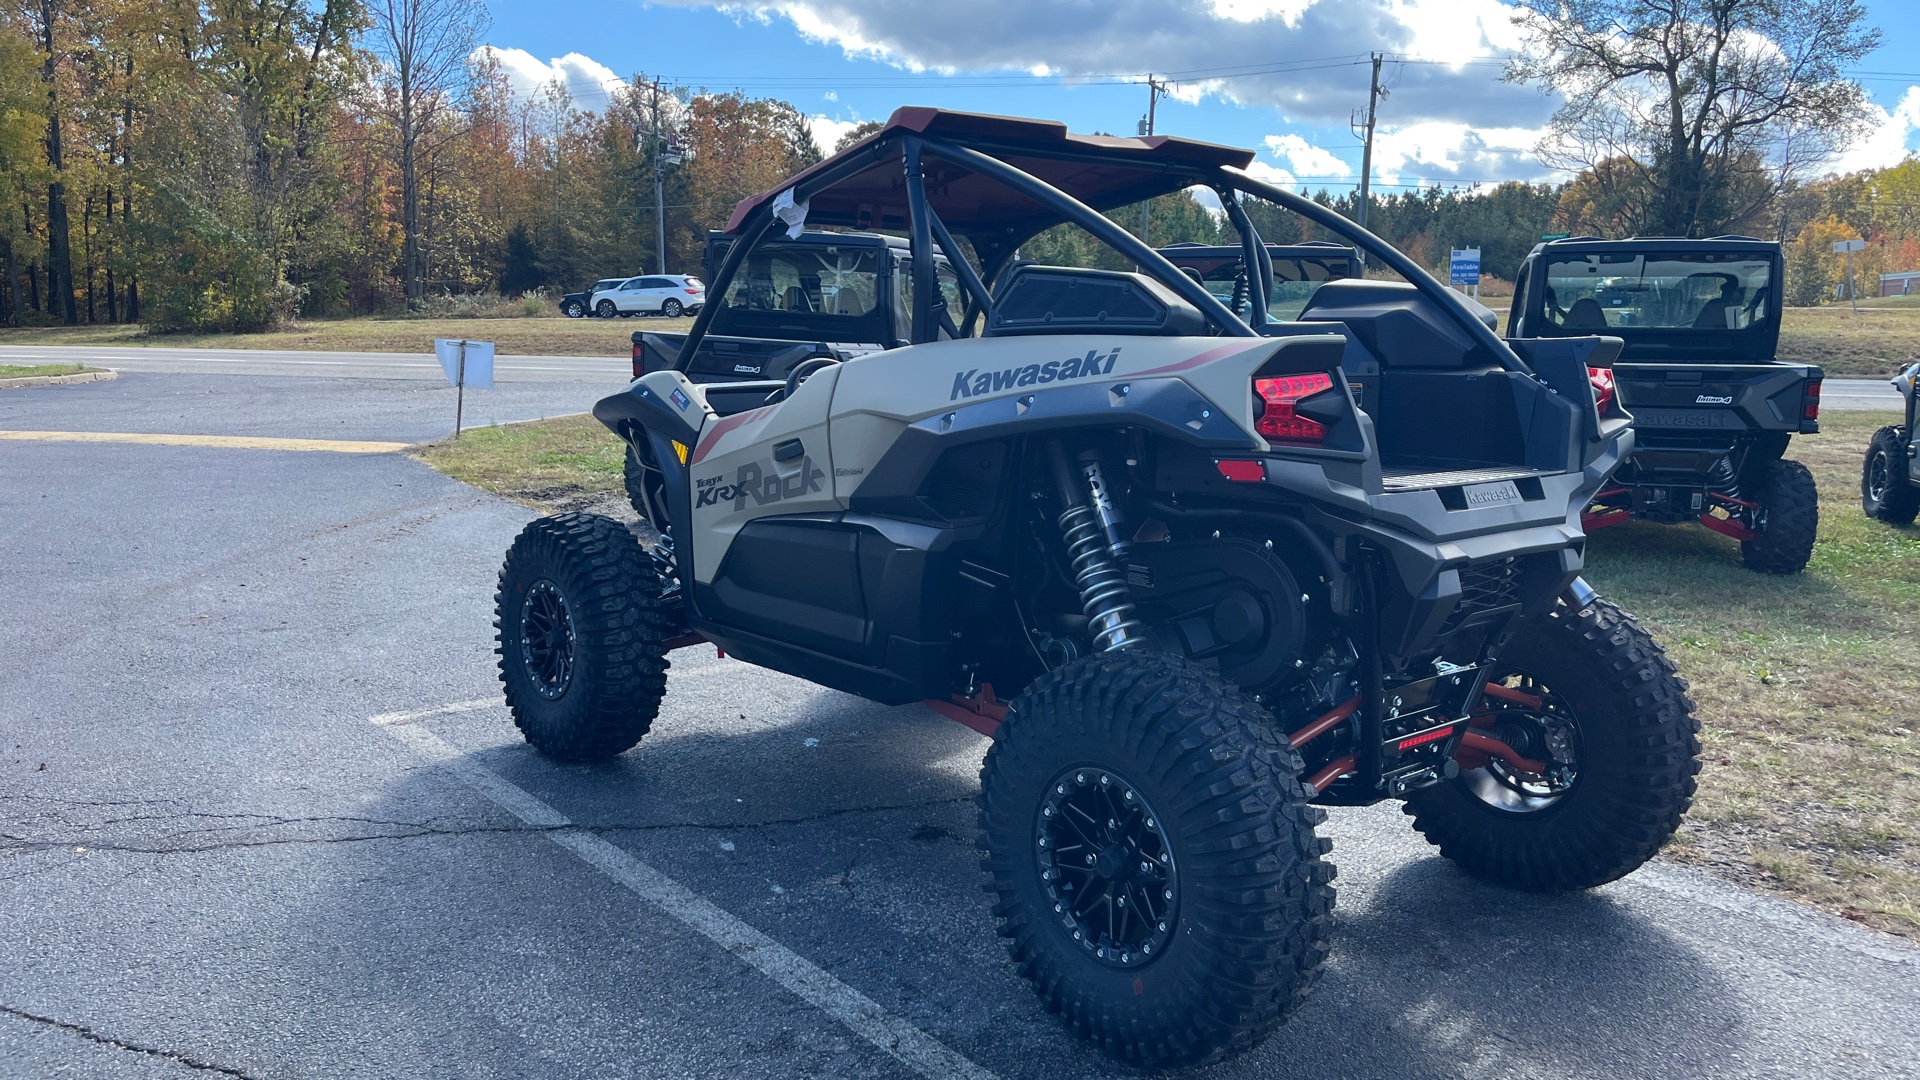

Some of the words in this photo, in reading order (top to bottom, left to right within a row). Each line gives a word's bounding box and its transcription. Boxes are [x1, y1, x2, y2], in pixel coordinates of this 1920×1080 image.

[950, 347, 1121, 400] Kawasaki
[1634, 411, 1728, 427] Kawasaki
[695, 481, 749, 509] KRX
[1083, 462, 1113, 515] FOX
[1466, 485, 1518, 504] Kawasaki
